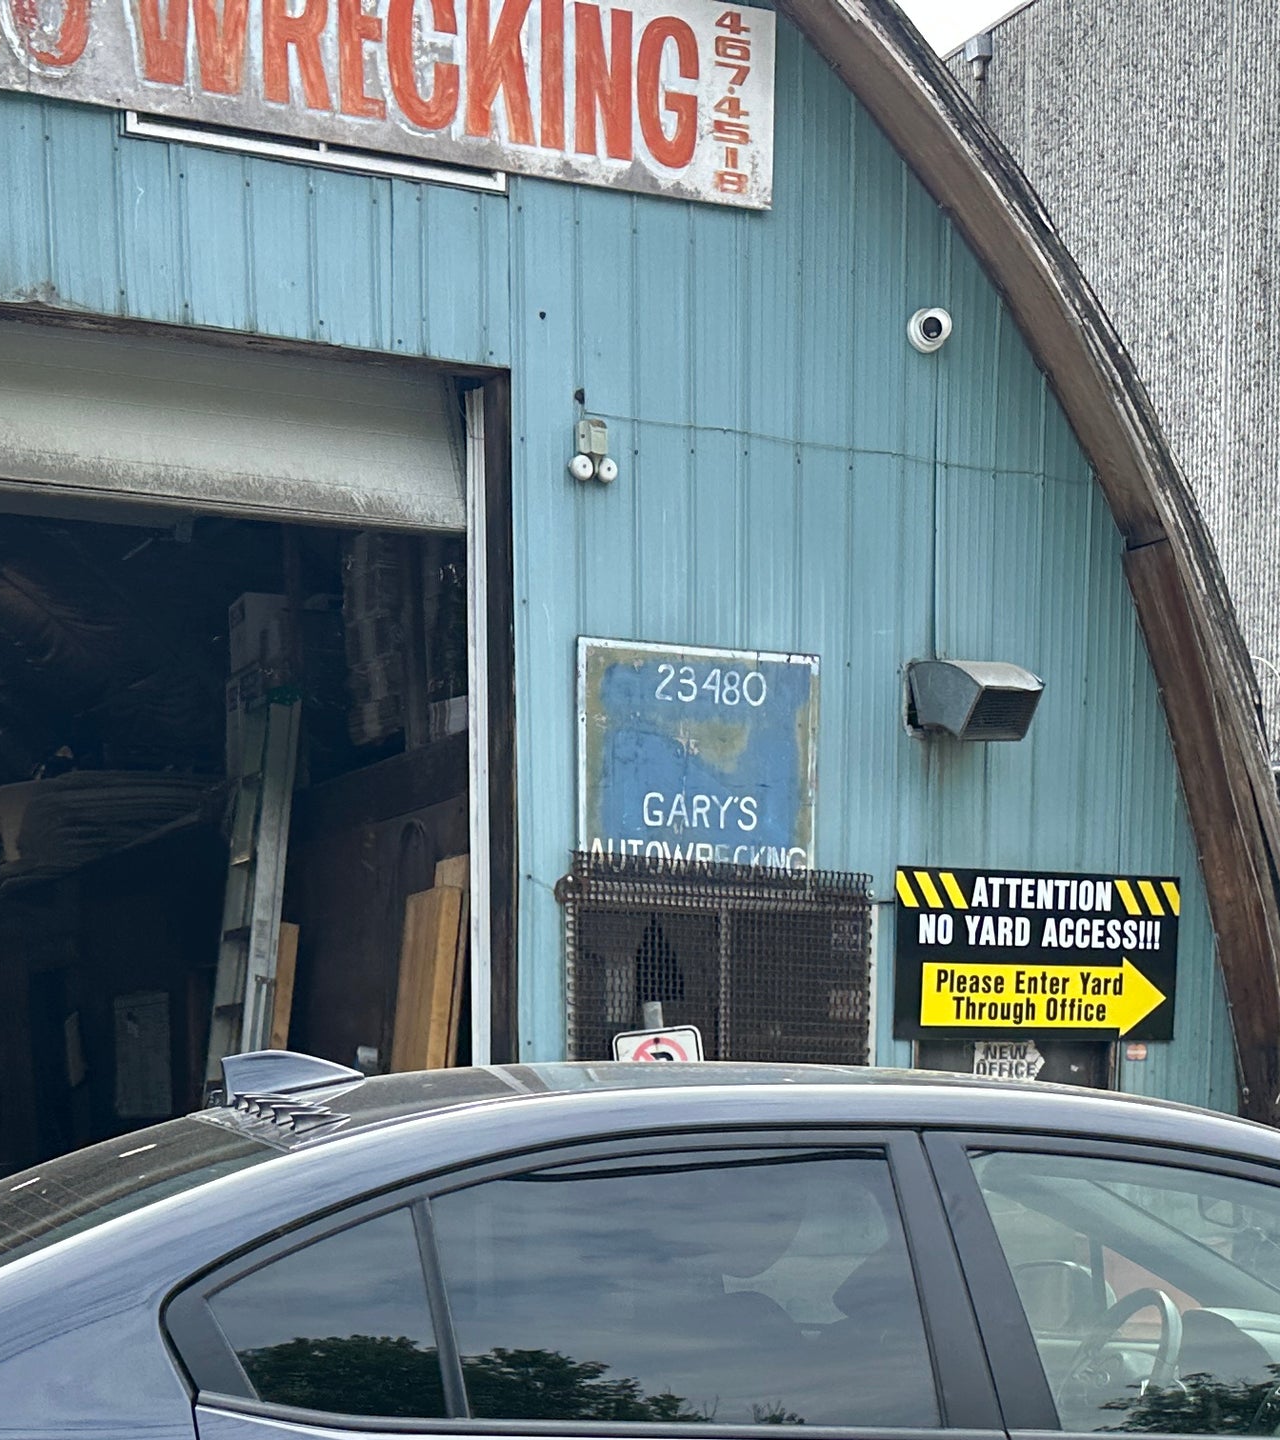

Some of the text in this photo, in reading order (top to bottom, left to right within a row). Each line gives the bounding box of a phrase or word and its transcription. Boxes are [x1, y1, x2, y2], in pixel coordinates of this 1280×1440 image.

[130, 0, 700, 169] WRECKING
[655, 663, 767, 707] 23480
[642, 791, 758, 832] GARY'S
[971, 876, 1113, 912] ATTENTION
[918, 913, 1161, 950] NO YARD ACCESS!!!
[936, 969, 1124, 996] Please Enter Yard
[952, 996, 1106, 1025] Through Office
[983, 1041, 1027, 1060] NEW
[976, 1059, 1036, 1079] OFFICE
